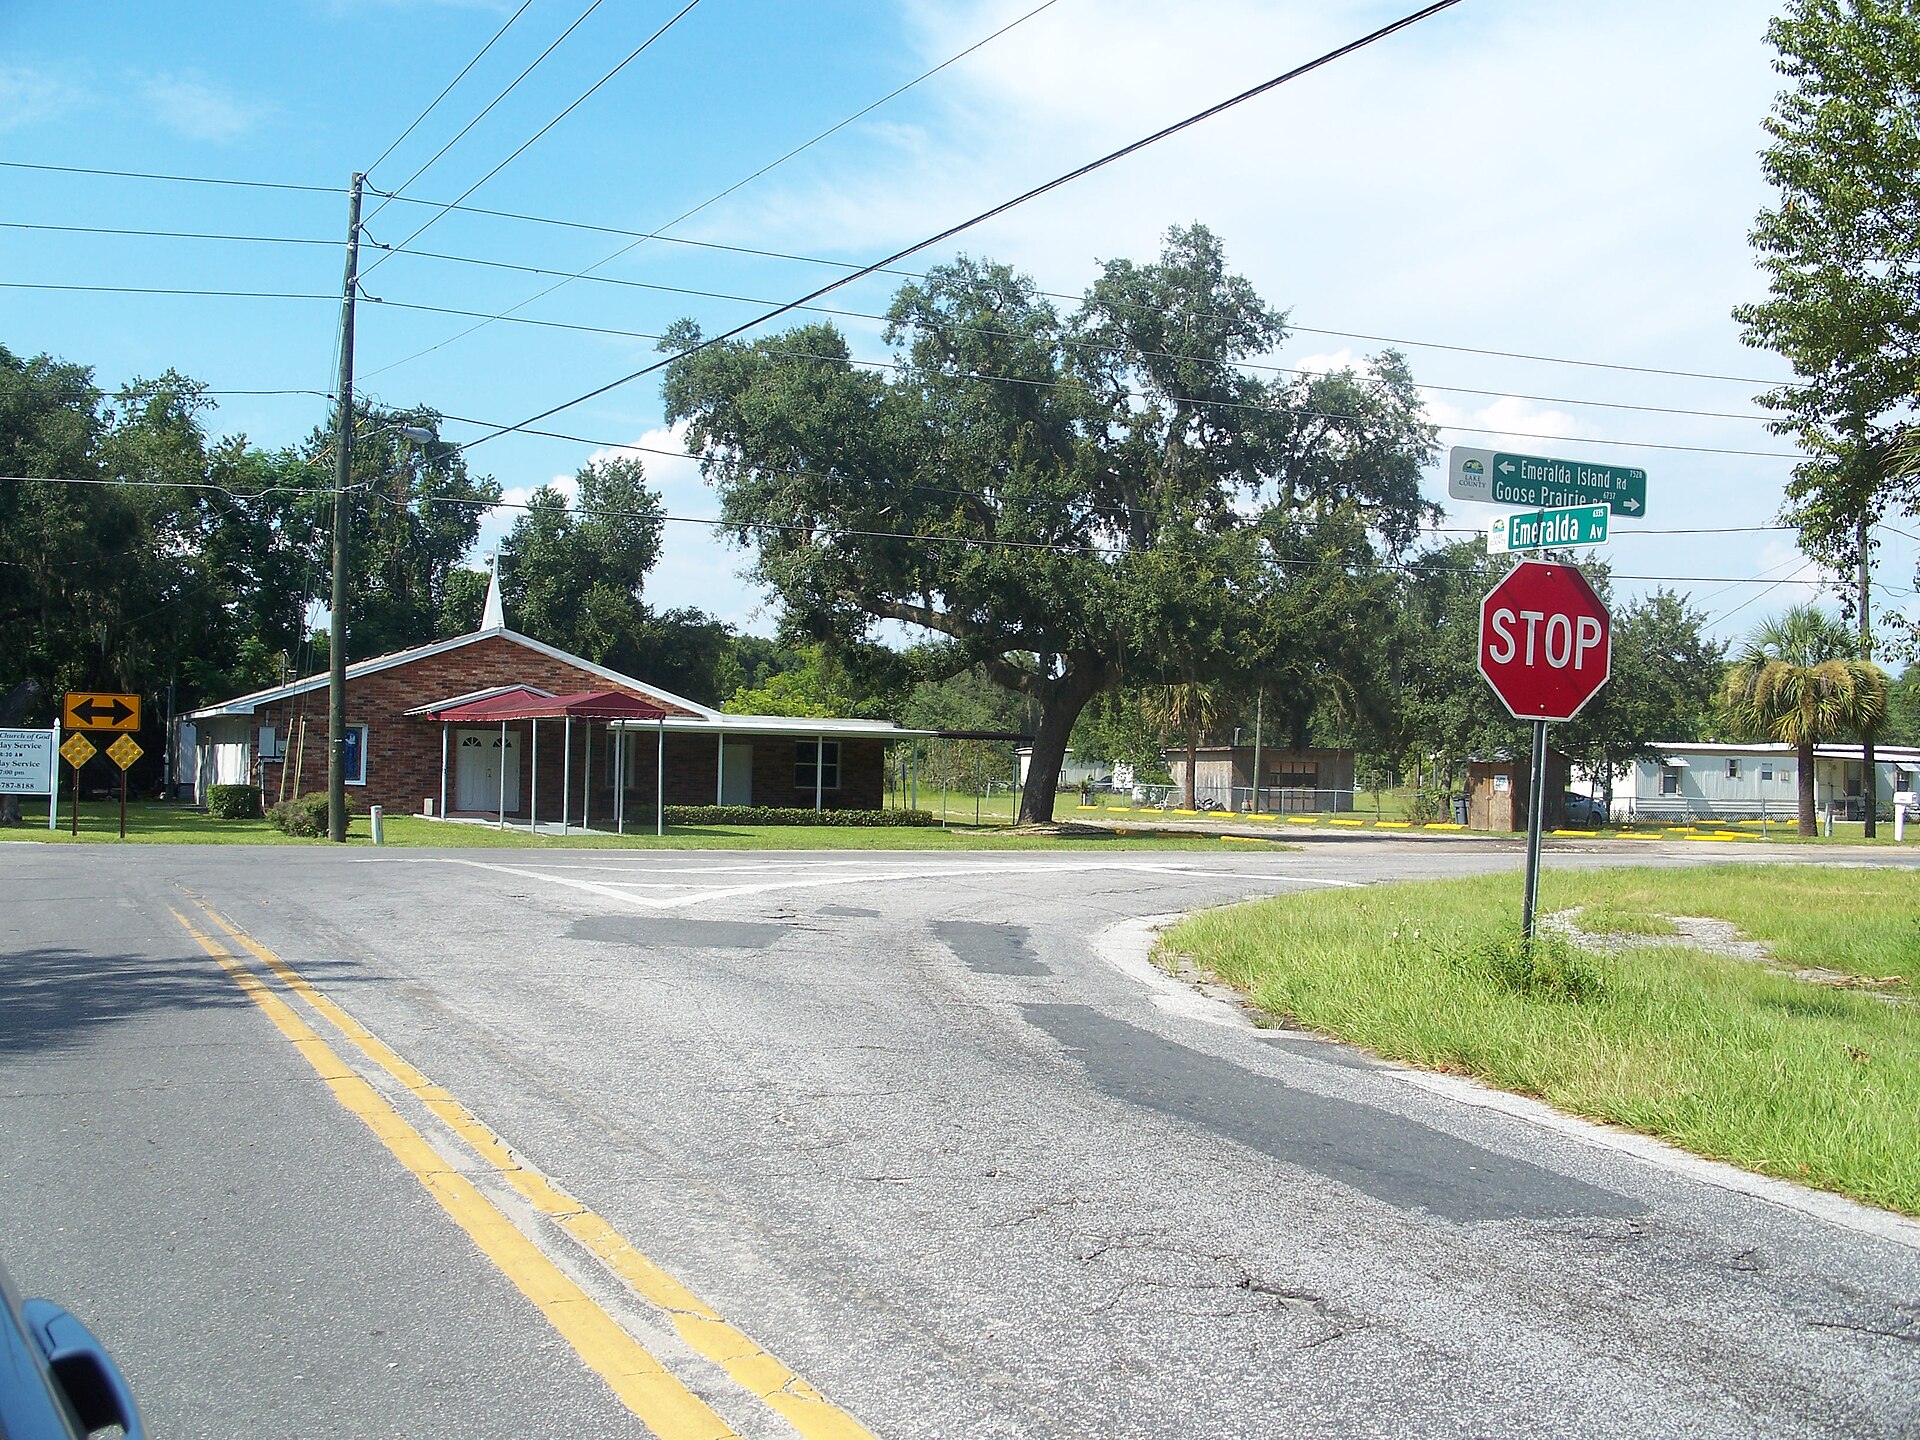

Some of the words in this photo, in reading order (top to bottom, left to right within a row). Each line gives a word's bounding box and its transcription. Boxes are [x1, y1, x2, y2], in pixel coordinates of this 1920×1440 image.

[1459, 480, 1486, 488] COUNTY
[1521, 460, 1571, 484] Emeralda
[1578, 467, 1610, 488] Island
[1616, 478, 1627, 490] Rd
[1496, 481, 1535, 503] Goose
[1541, 486, 1586, 506] Prairie
[1513, 513, 1579, 546] Emeralda
[1589, 523, 1603, 540] Av
[1489, 608, 1602, 670] STOP
[26, 733, 35, 741] of
[12, 760, 40, 768] Service
